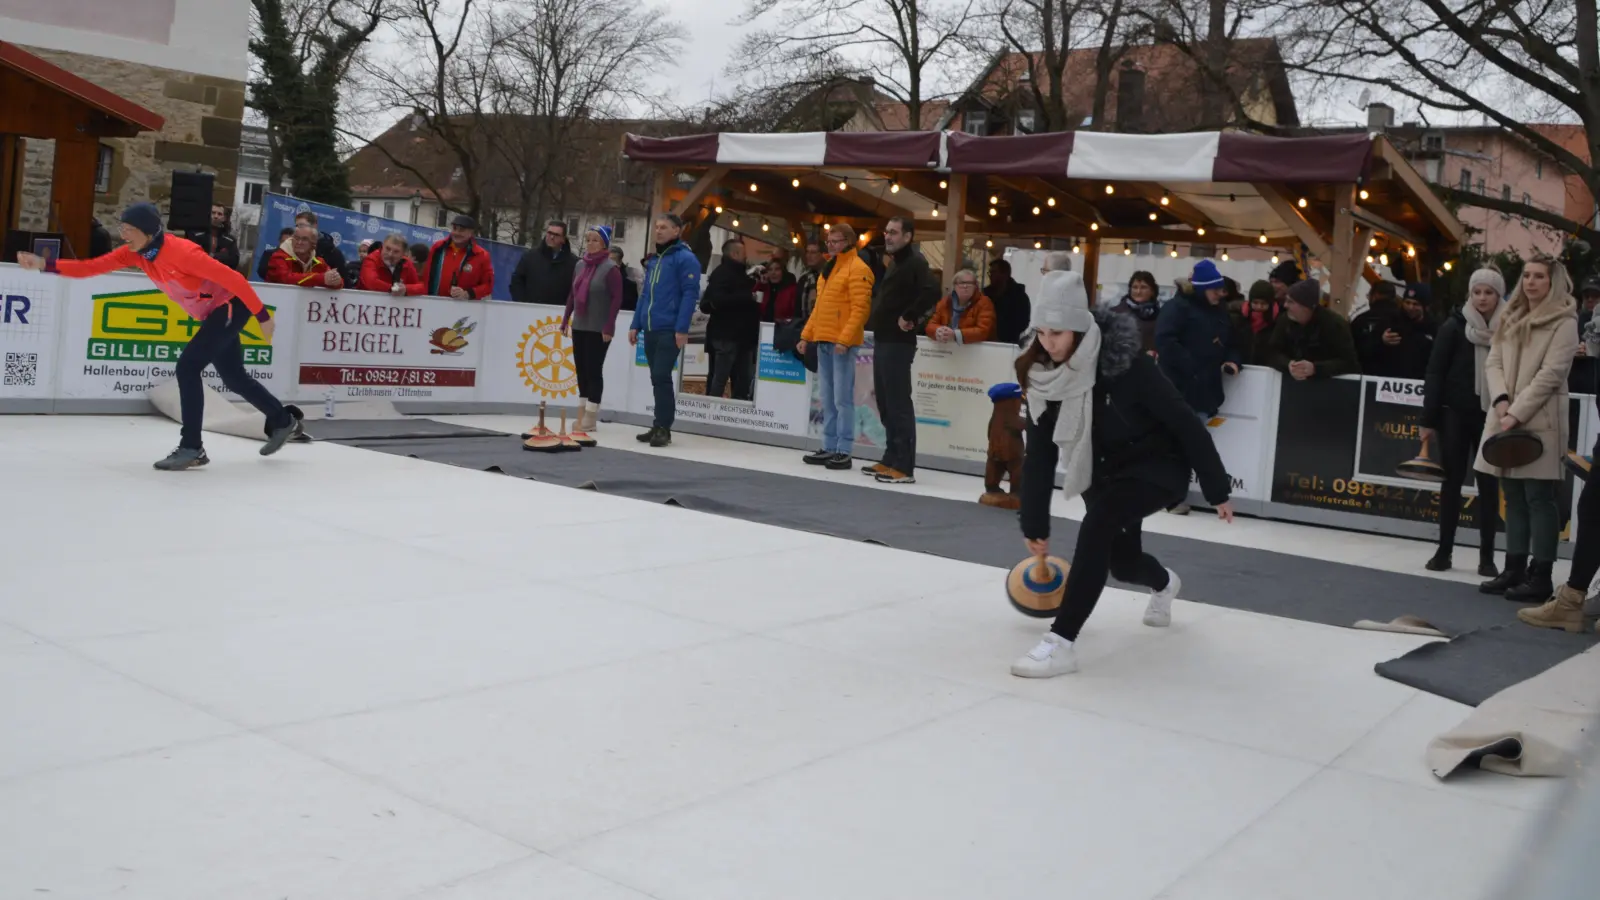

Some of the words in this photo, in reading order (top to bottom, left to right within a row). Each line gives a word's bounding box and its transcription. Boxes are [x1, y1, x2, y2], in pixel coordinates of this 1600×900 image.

[273, 201, 296, 214] Rotary
[345, 216, 366, 229] Rotary
[412, 230, 432, 242] Rotary
[0, 294, 31, 324] R
[307, 297, 423, 328] BÄCKEREI
[322, 330, 404, 354] BEIGEL
[340, 368, 363, 383] Tel.:
[365, 370, 399, 383] 09842
[422, 371, 437, 384] 82
[917, 380, 927, 389] Für
[927, 381, 945, 390] jeden
[945, 383, 957, 391] das
[957, 385, 985, 395] Richtige.
[719, 404, 775, 418] RECHTSBERATUNG
[712, 414, 789, 431] UNTERNEHMENSBERATUNG
[1287, 471, 1325, 491] Tel:
[1331, 477, 1405, 501] 09842
